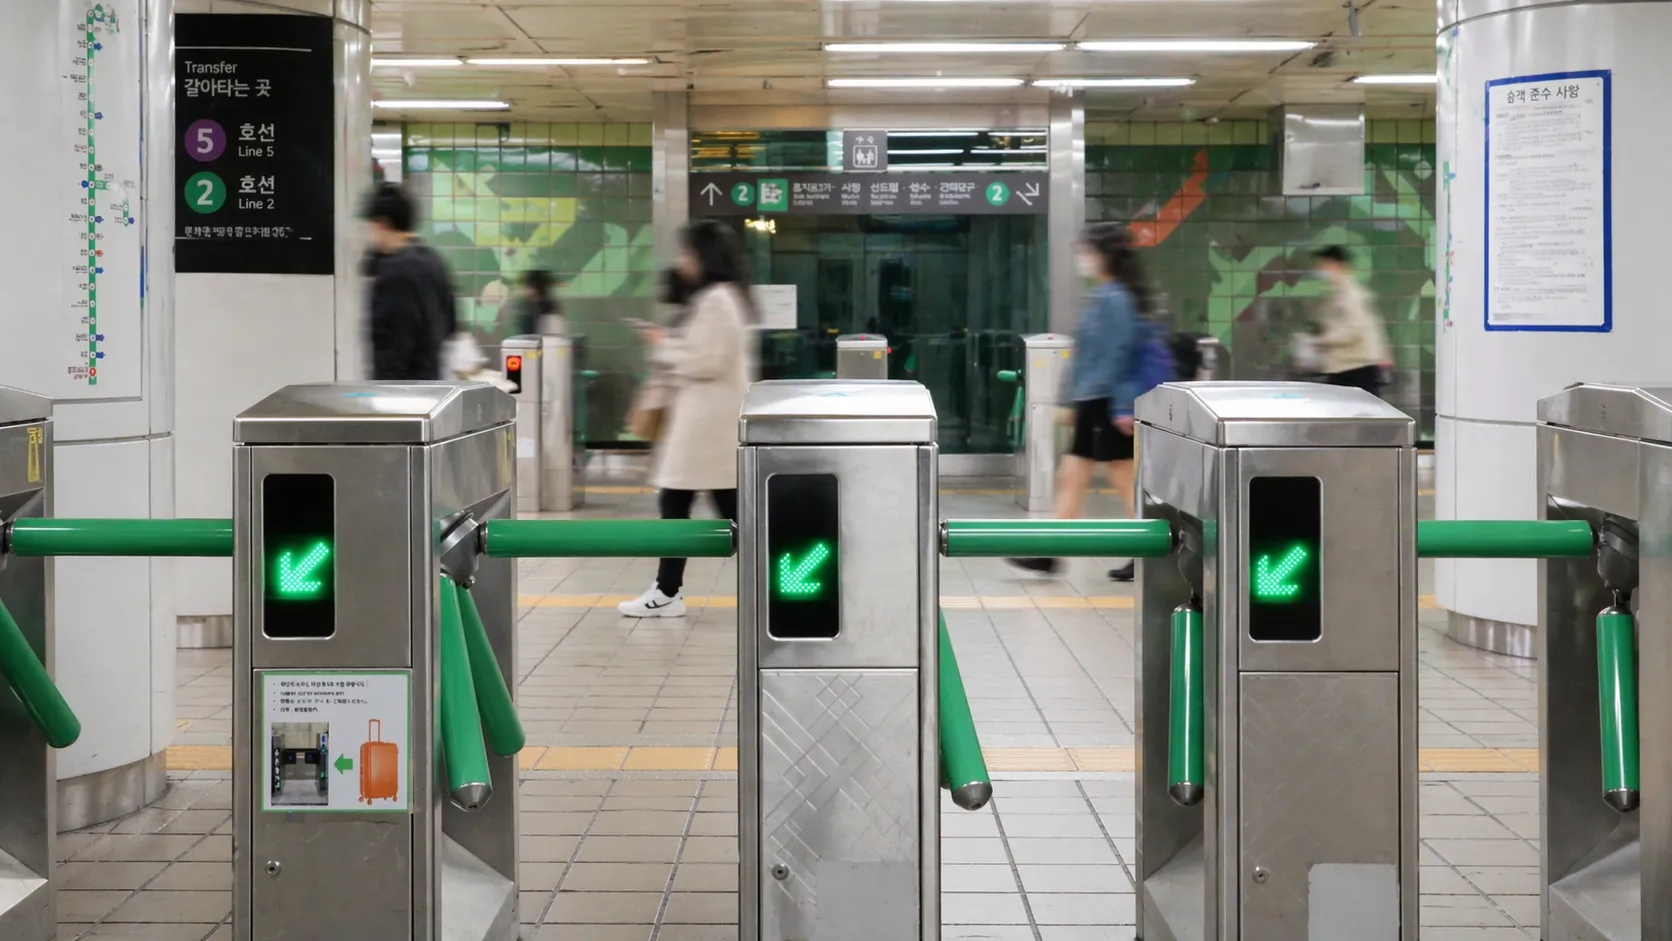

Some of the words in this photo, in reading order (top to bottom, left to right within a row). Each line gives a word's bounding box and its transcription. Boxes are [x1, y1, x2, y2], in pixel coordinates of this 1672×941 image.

[185, 61, 238, 74] Transfer
[184, 78, 250, 97] 갈아타는
[255, 79, 272, 97] 곳
[1530, 87, 1551, 102] 준수
[238, 123, 275, 142] 호선
[196, 128, 214, 154] 5
[238, 146, 263, 157] Line
[266, 146, 274, 157] 5
[196, 179, 214, 206] 2
[738, 186, 748, 201] 2
[992, 185, 1003, 201] 2
[238, 199, 264, 210] Line
[266, 199, 275, 210] 2
